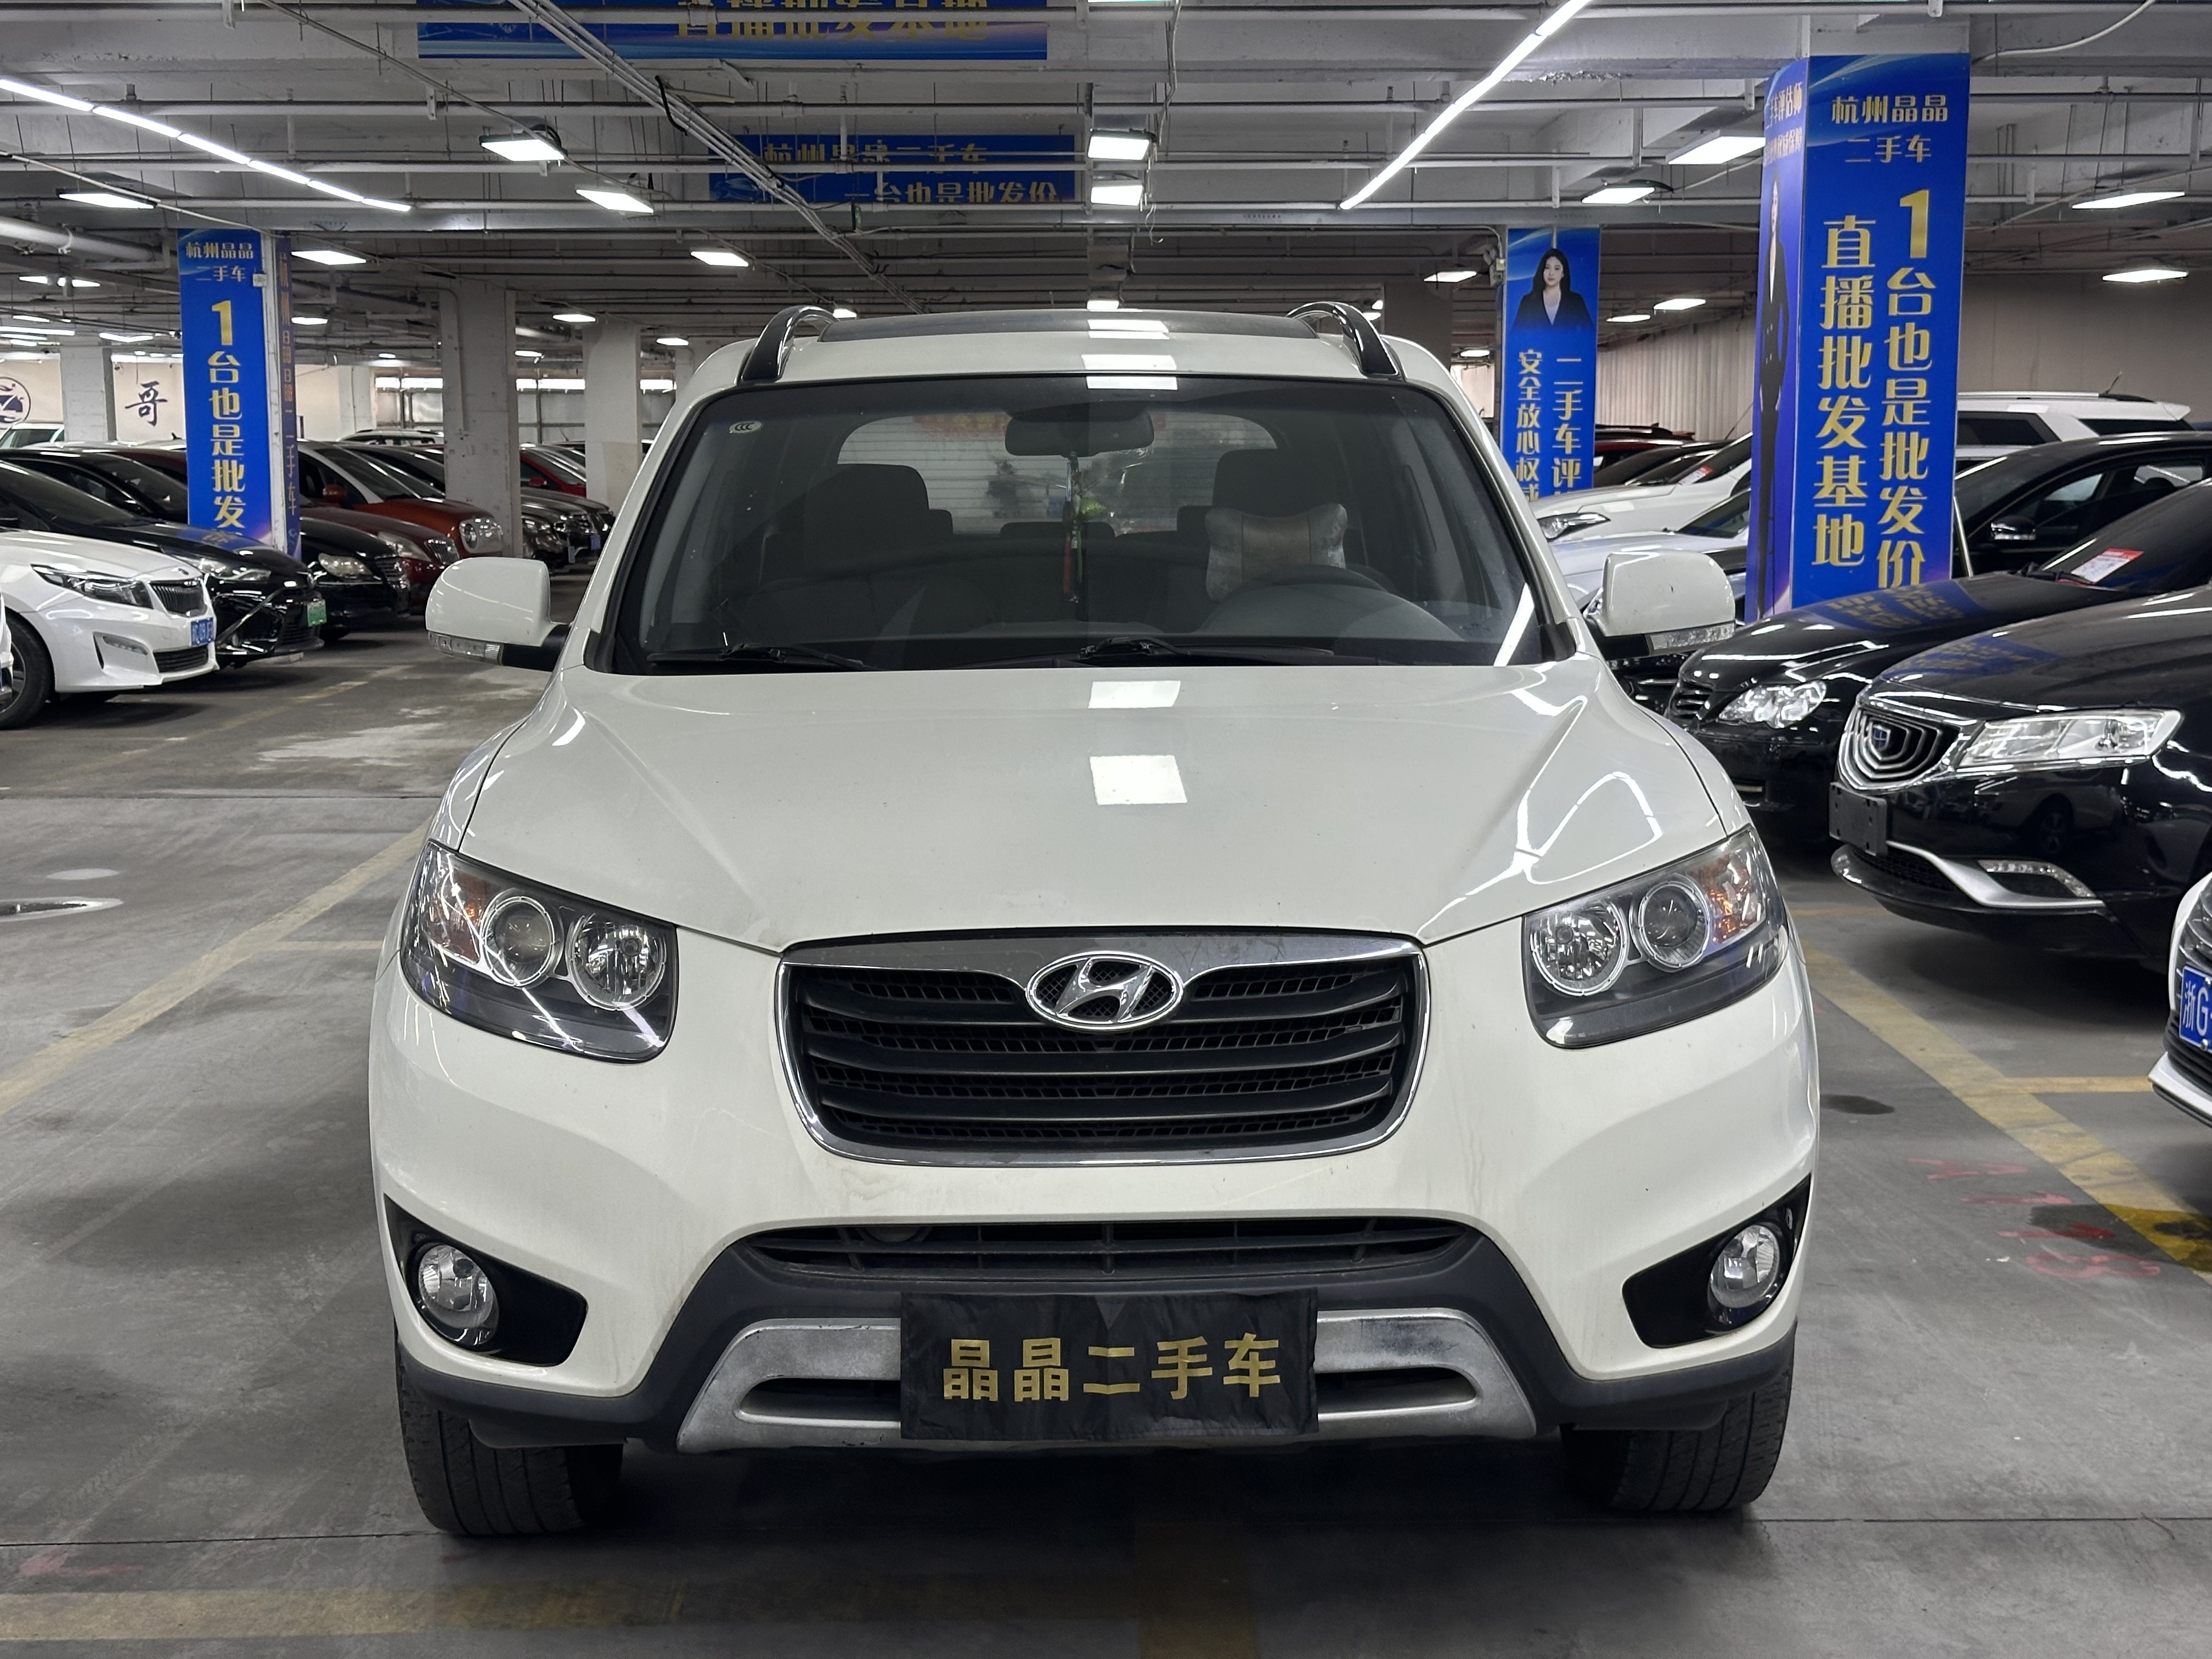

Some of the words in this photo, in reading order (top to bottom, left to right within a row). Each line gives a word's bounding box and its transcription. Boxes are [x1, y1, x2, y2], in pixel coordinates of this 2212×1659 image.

[1832, 95, 1948, 124] 杭州晶晶
[1845, 134, 1931, 163] 二手车
[187, 241, 253, 259] 杭州晶晶
[196, 266, 246, 282] 二手车
[125, 381, 168, 427] 哥
[207, 300, 246, 536] 1台也是批发
[1812, 215, 1876, 567] 直播批发基地
[1877, 190, 1936, 589] 1台也是批发价
[1551, 358, 1584, 494] 二手车评
[943, 1333, 1281, 1402] 晶晶二手车
